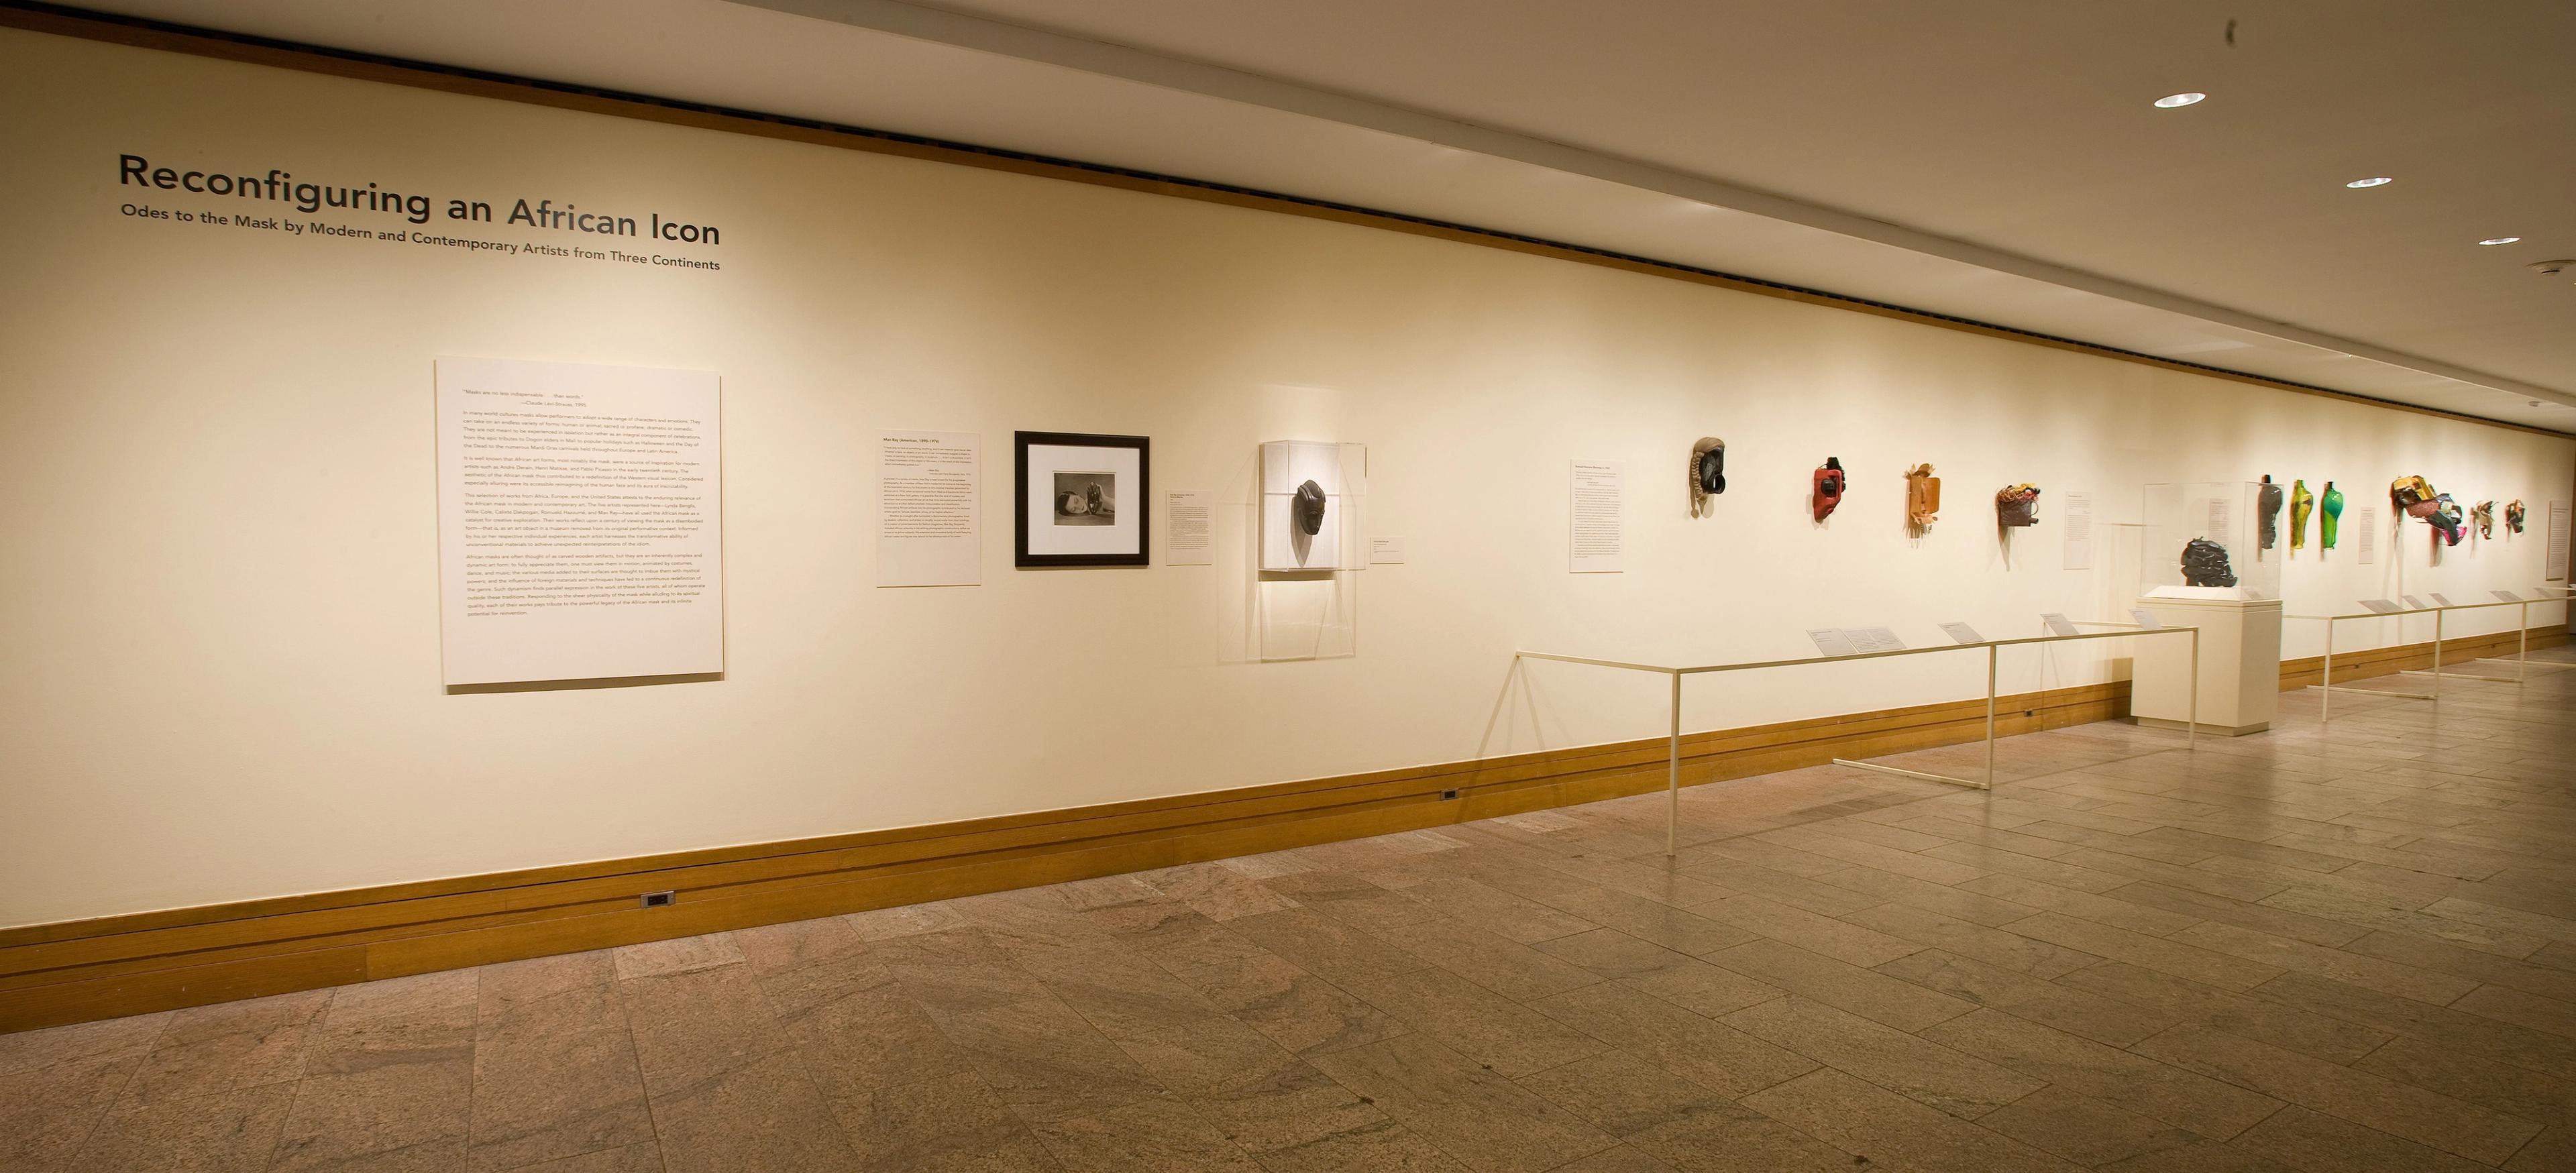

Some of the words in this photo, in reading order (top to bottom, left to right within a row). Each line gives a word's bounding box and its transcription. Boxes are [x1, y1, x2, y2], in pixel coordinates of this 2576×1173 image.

[119, 154, 431, 225] Reconfiguring
[447, 199, 492, 223] an
[506, 198, 637, 237] African
[651, 213, 720, 245] Icon
[120, 203, 169, 220] Odes
[174, 210, 195, 222] to
[199, 211, 229, 225] the
[235, 214, 279, 231] Mask
[284, 218, 305, 235] by
[311, 222, 372, 239] Modern
[378, 230, 407, 243] and
[411, 231, 519, 256] Contemporary
[523, 242, 569, 258] Artists
[573, 246, 605, 260] from
[609, 249, 648, 264] Three
[651, 254, 720, 271] Continents
